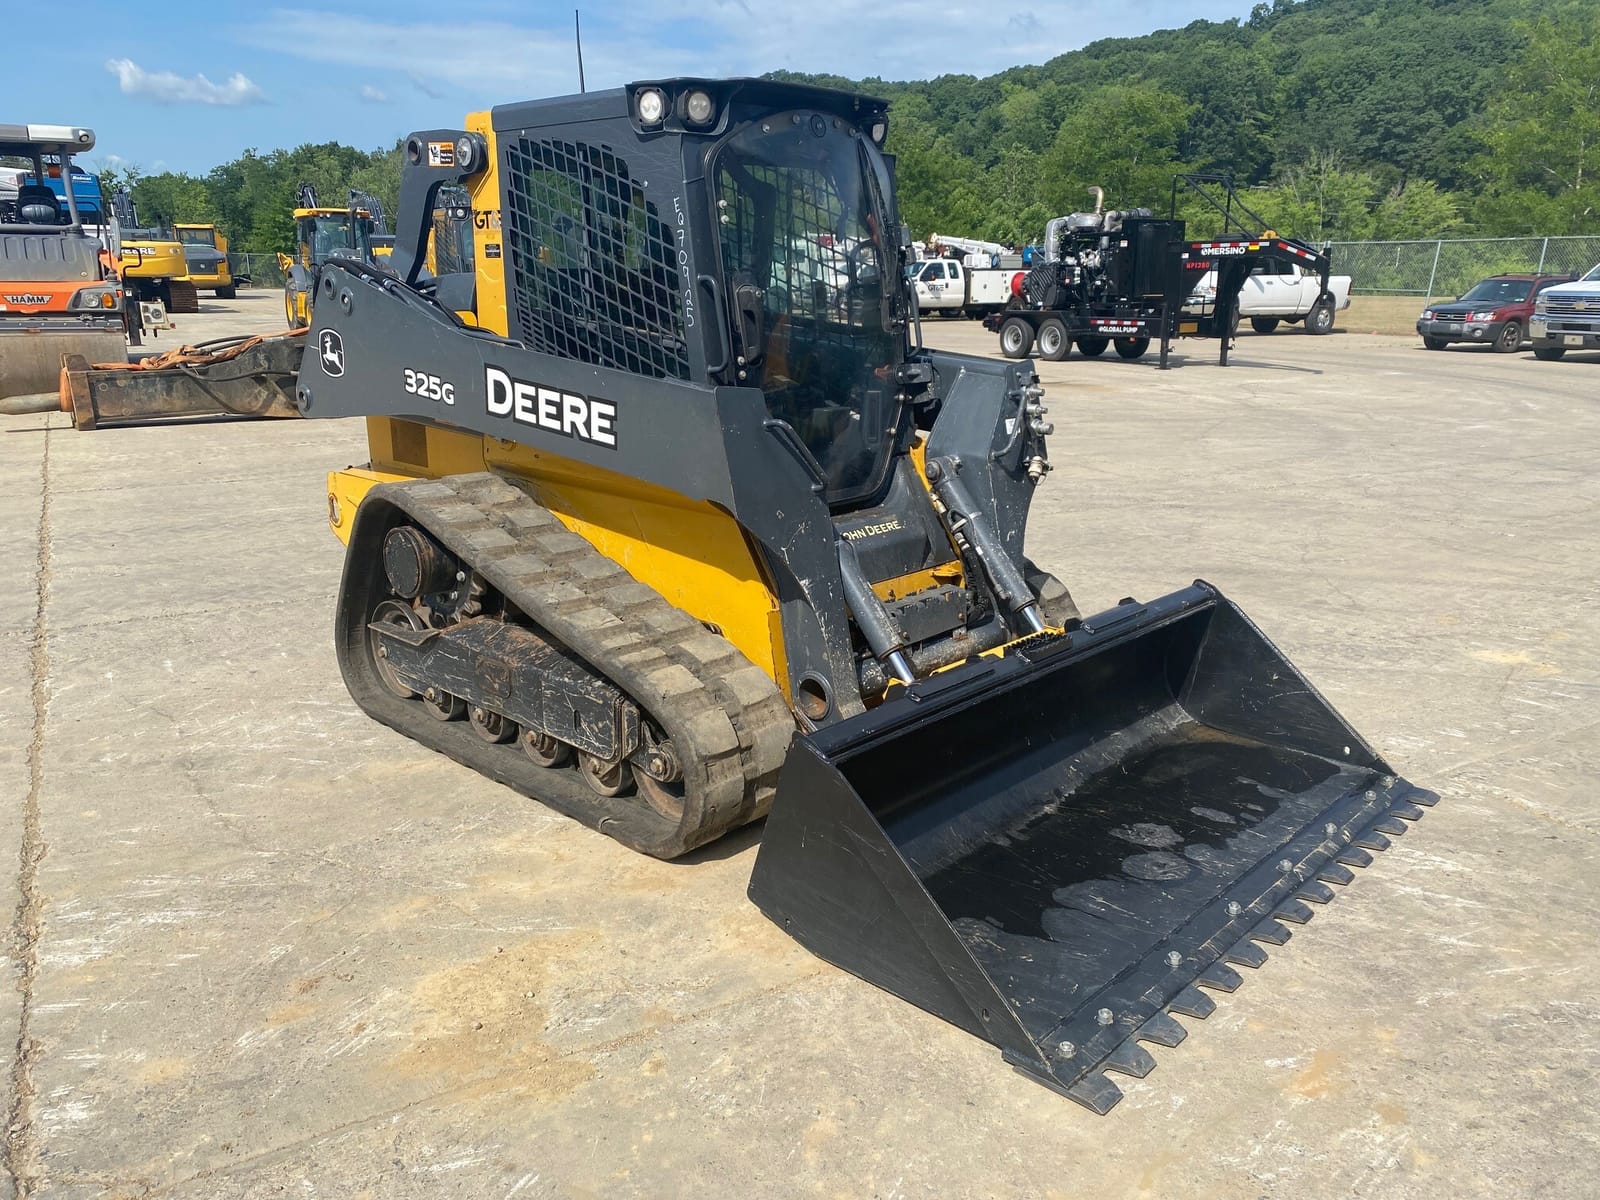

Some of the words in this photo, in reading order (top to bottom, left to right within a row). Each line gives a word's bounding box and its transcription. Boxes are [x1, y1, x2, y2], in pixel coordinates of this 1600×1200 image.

[1207, 247, 1246, 256] MERSINO
[404, 368, 455, 405] 325G
[486, 366, 617, 447] DEERE
[865, 520, 902, 536] DEERE
